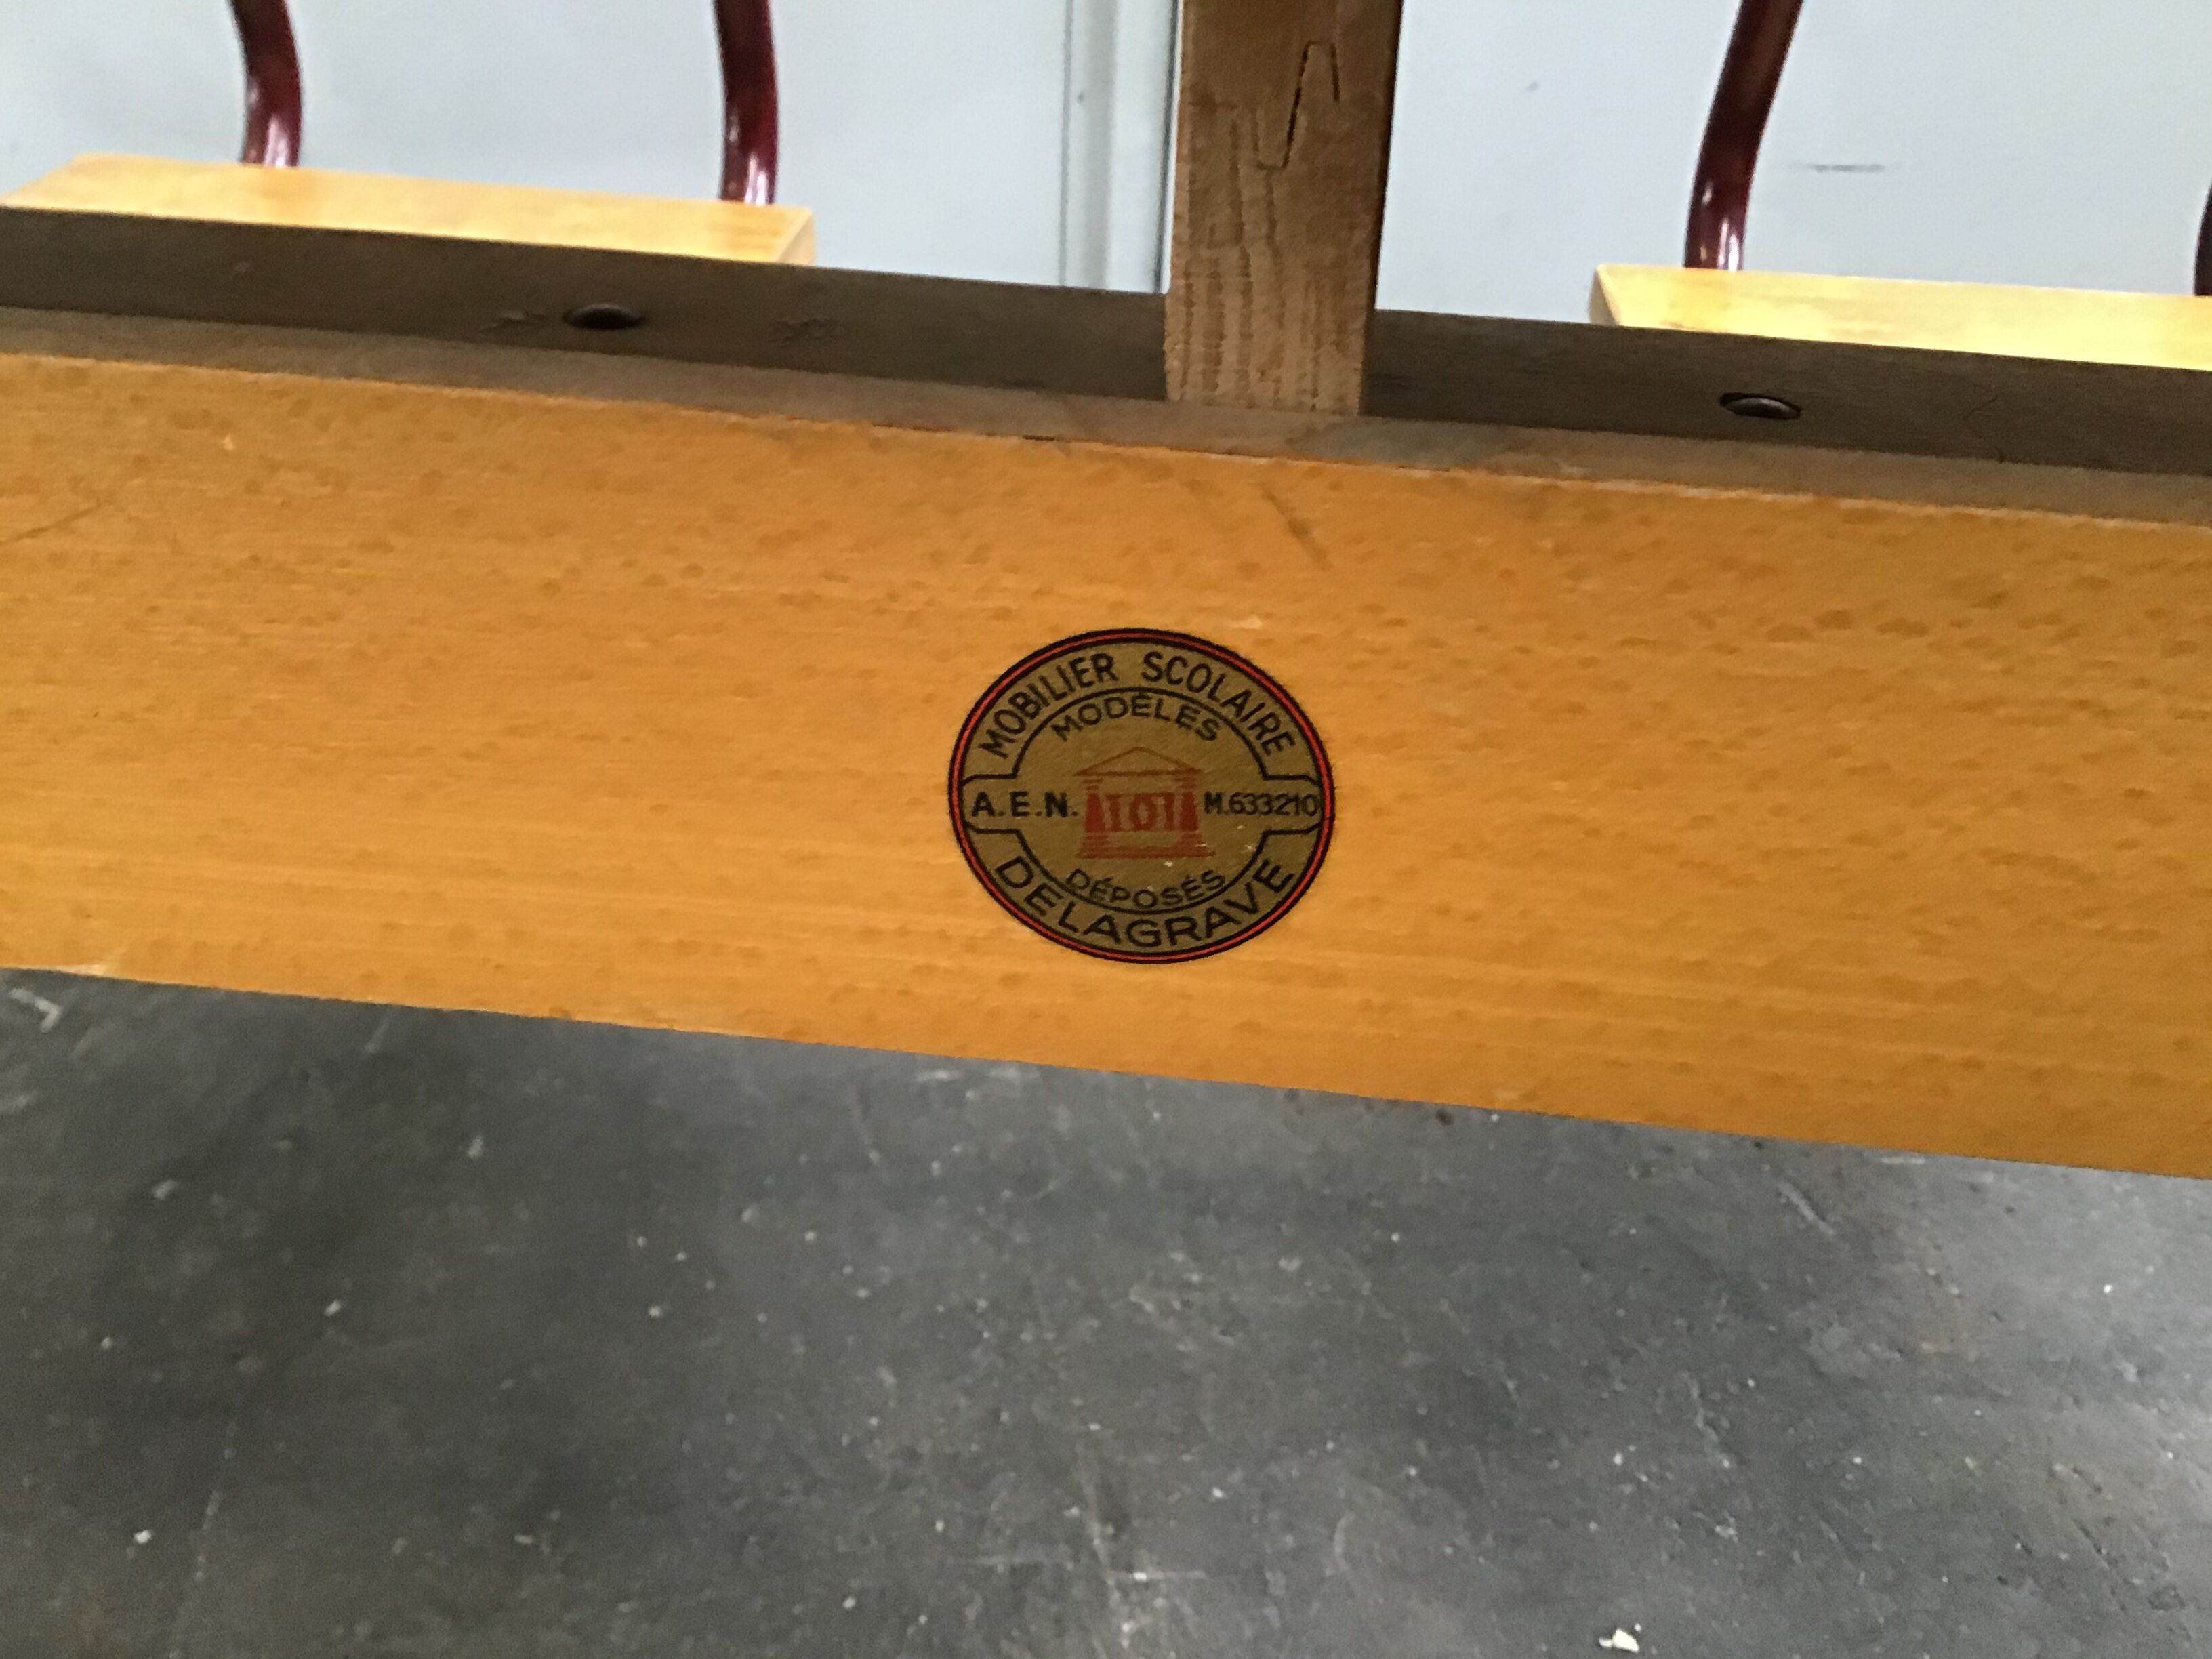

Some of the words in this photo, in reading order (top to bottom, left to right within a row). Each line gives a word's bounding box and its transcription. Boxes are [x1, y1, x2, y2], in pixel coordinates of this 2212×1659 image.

[978, 653, 1120, 760] MOBILIER
[1141, 651, 1296, 757] SCOLAIRE
[996, 856, 1295, 947] DELAGRAVE
